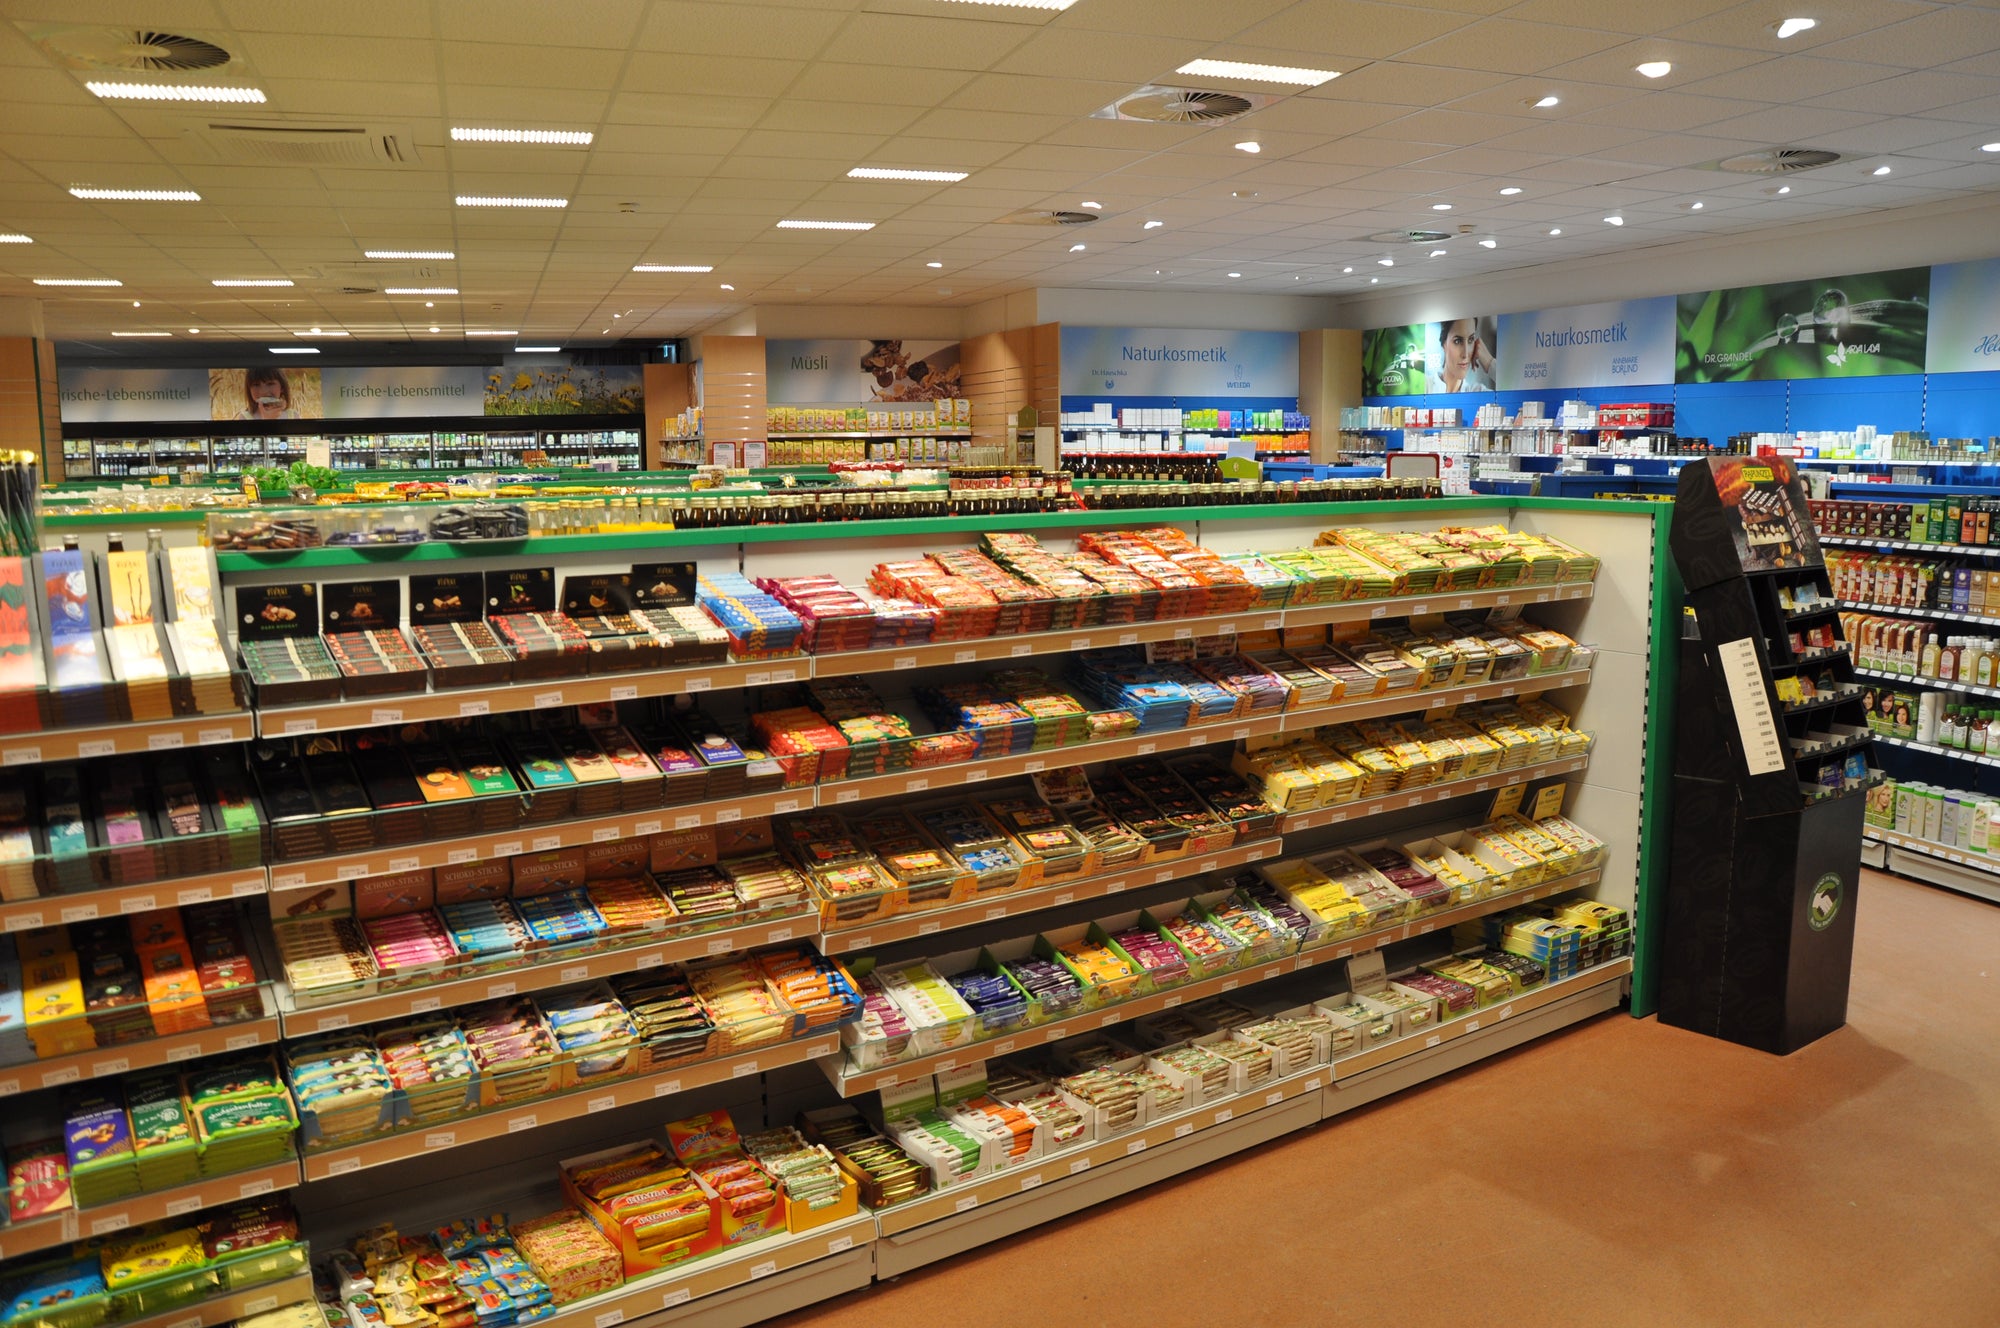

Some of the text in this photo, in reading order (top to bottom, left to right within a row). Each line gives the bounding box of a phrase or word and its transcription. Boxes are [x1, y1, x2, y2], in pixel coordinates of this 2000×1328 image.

[1535, 322, 1628, 348] Naturkosmetik
[1974, 334, 2000, 356] Hel
[1122, 345, 1227, 362] Naturkosmetik
[790, 355, 828, 370] Müsli
[340, 384, 465, 398] Frische-Lebensmittel
[1227, 381, 1251, 389] WELEDA
[61, 387, 191, 401] rische-Lebensmittel
[1743, 469, 1773, 479] RAPUNZEL
[657, 833, 709, 847] SCHOKO-STICKS
[588, 843, 643, 858] SCHOKO-STICKS
[444, 866, 503, 881] SCHOKO-STICKS
[521, 860, 578, 875] SCHOKO-STICKS
[364, 875, 425, 891] SCHOKO-STICKS
[786, 976, 816, 988] molino
[788, 987, 818, 1000] molino
[679, 1131, 711, 1152] RUMBA
[627, 1189, 668, 1204] RUMBA
[639, 1208, 681, 1224] RUMBA
[730, 1222, 759, 1240] RUMBA
